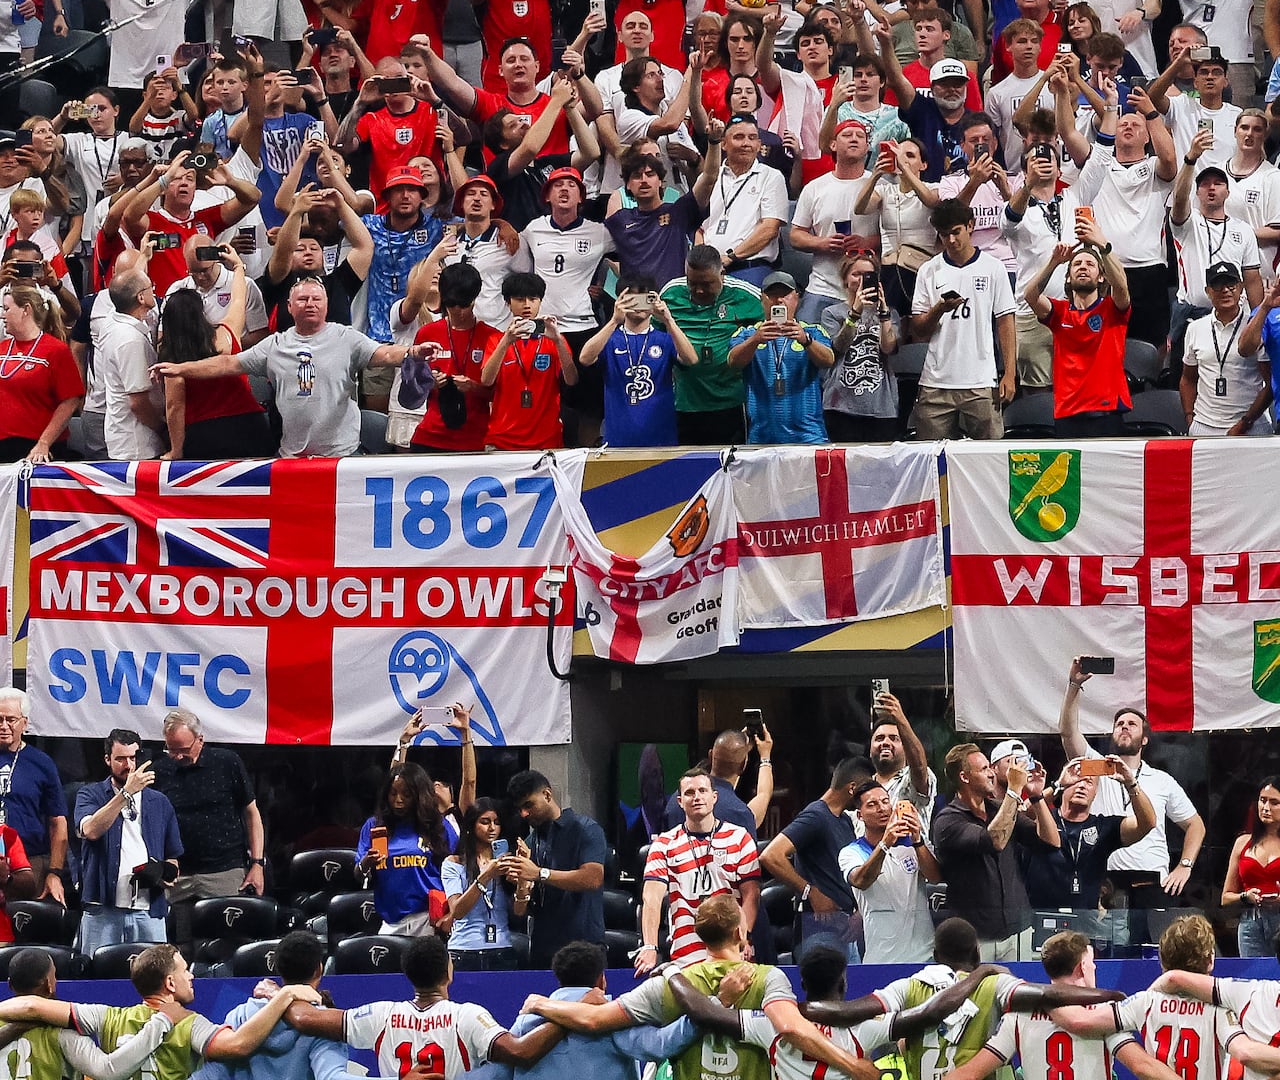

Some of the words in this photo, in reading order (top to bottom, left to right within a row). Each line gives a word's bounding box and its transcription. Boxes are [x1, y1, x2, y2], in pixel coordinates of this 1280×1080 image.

[554, 254, 564, 274] 8
[365, 476, 558, 550] 1867
[843, 509, 926, 539] HAMLET
[39, 568, 404, 618] MEXBOROUGH
[418, 576, 563, 620] OWLS
[48, 647, 253, 710] SWFC
[393, 855, 428, 869] CONGO
[1046, 1030, 1075, 1080] 8
[1154, 1024, 1201, 1080] 18
